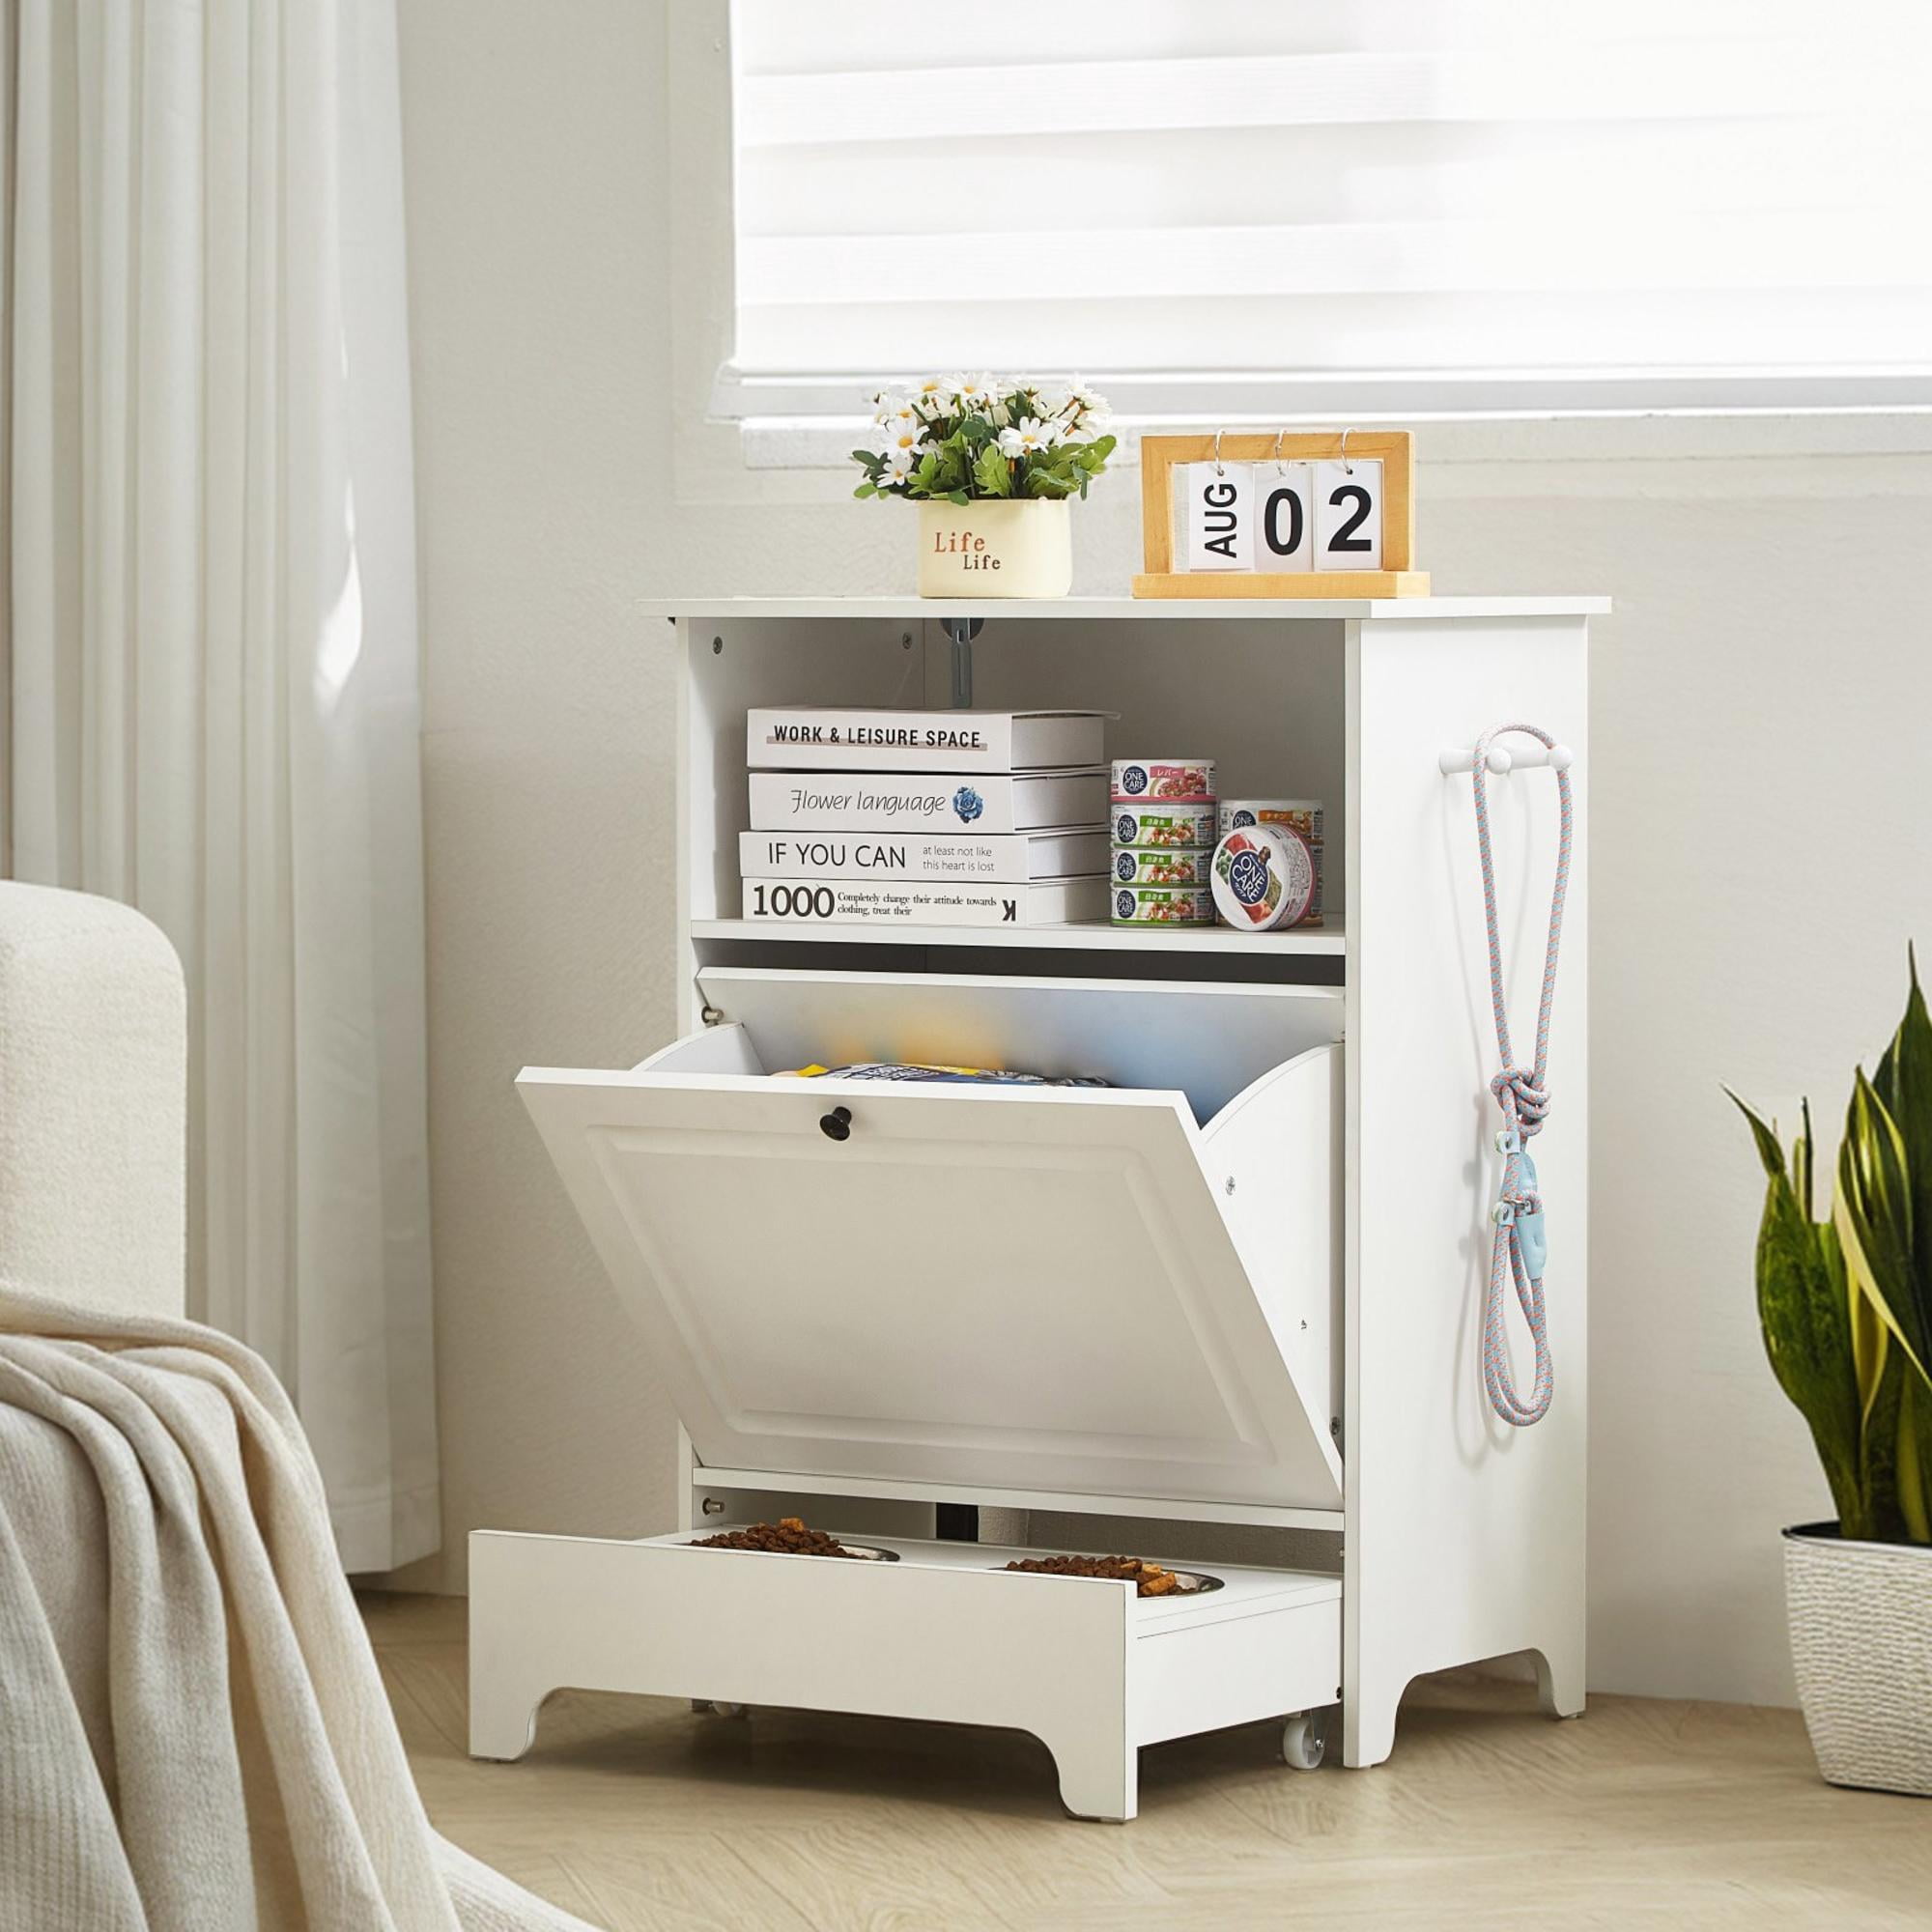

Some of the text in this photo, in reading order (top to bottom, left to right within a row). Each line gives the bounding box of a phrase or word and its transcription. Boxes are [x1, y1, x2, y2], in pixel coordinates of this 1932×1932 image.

[1204, 483, 1237, 559] AUG
[934, 531, 985, 553] Life
[963, 554, 1001, 570] Life
[774, 724, 980, 749] WORK & LEISURE SPACE
[1124, 772, 1144, 781] ONE
[1123, 781, 1145, 790] CARE
[790, 789, 947, 816] Flower language
[1119, 820, 1134, 829] ONE
[1235, 816, 1253, 827] ONE
[1119, 829, 1135, 838] CARE
[768, 842, 906, 868] IF YOU CAN
[923, 845, 993, 857] at least not like
[923, 859, 995, 872] this heart is lost
[1119, 858, 1133, 867] ONE
[1239, 855, 1266, 887] ONE
[1232, 864, 1260, 902] CARE
[753, 885, 836, 919] 1000
[838, 892, 998, 907] Completely change their attitude towards
[1118, 895, 1132, 904] ONE
[872, 905, 891, 915] treat
[894, 906, 913, 916] their
[1118, 904, 1134, 913] CARE
